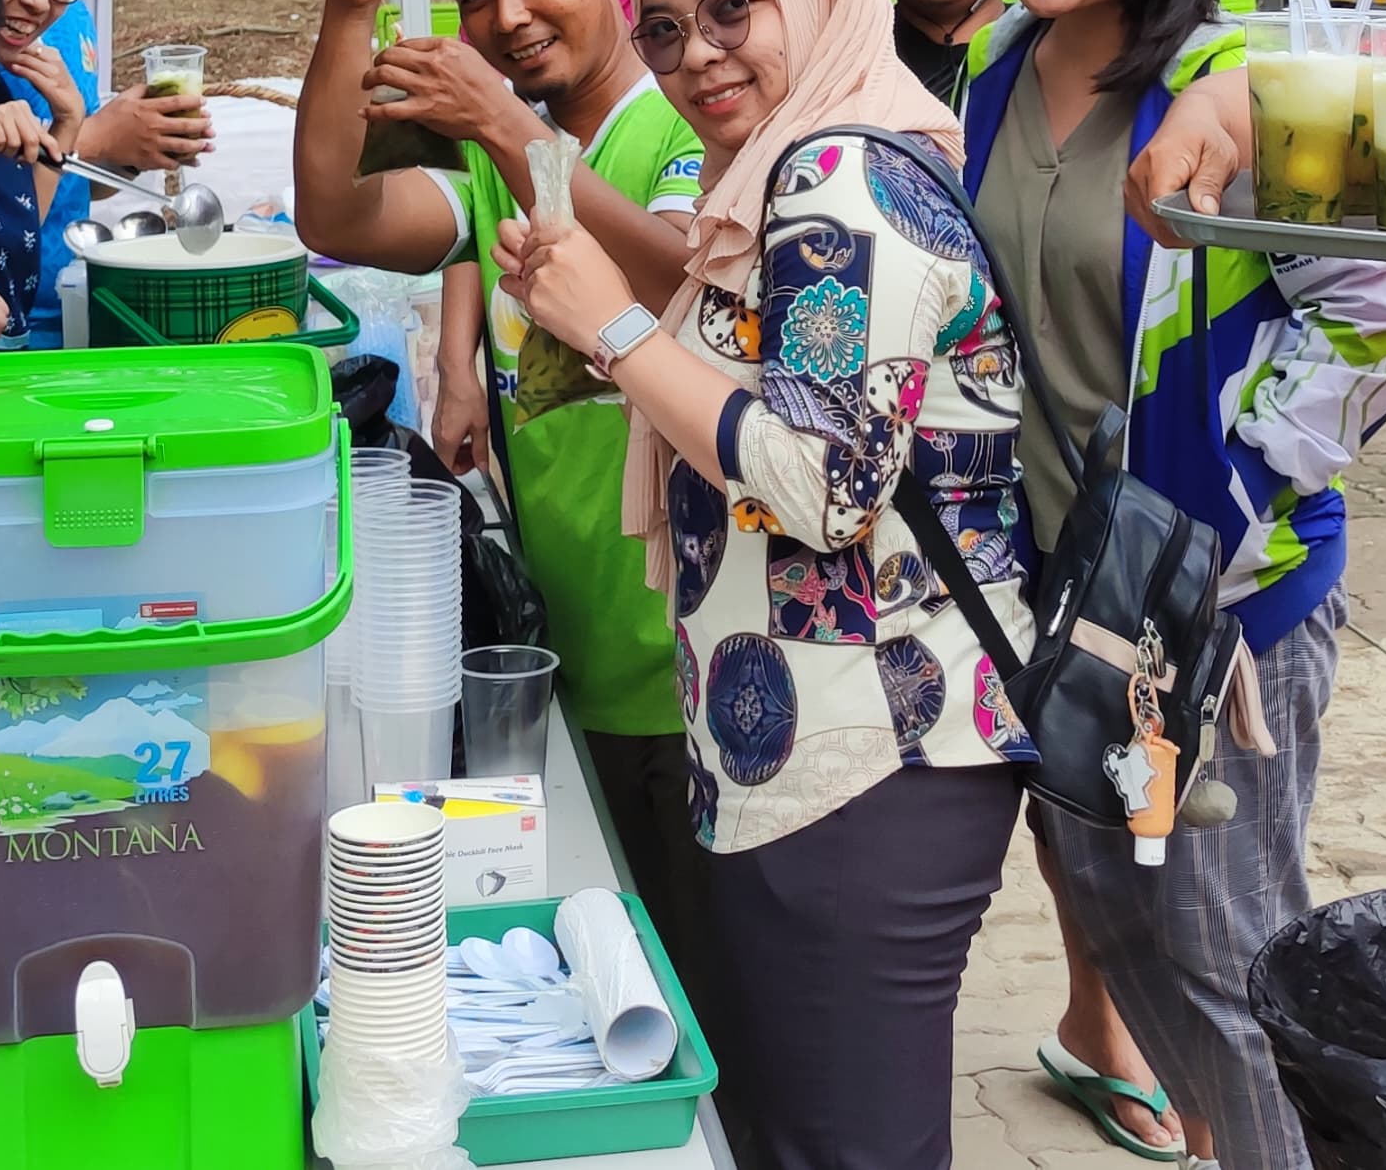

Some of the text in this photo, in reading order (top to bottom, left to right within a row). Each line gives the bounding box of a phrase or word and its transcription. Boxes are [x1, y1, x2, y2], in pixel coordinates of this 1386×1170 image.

[1276, 258, 1313, 275] RUMAH
[134, 740, 192, 784] 27
[135, 786, 190, 804] LITRES
[5, 822, 205, 863] MONTANA
